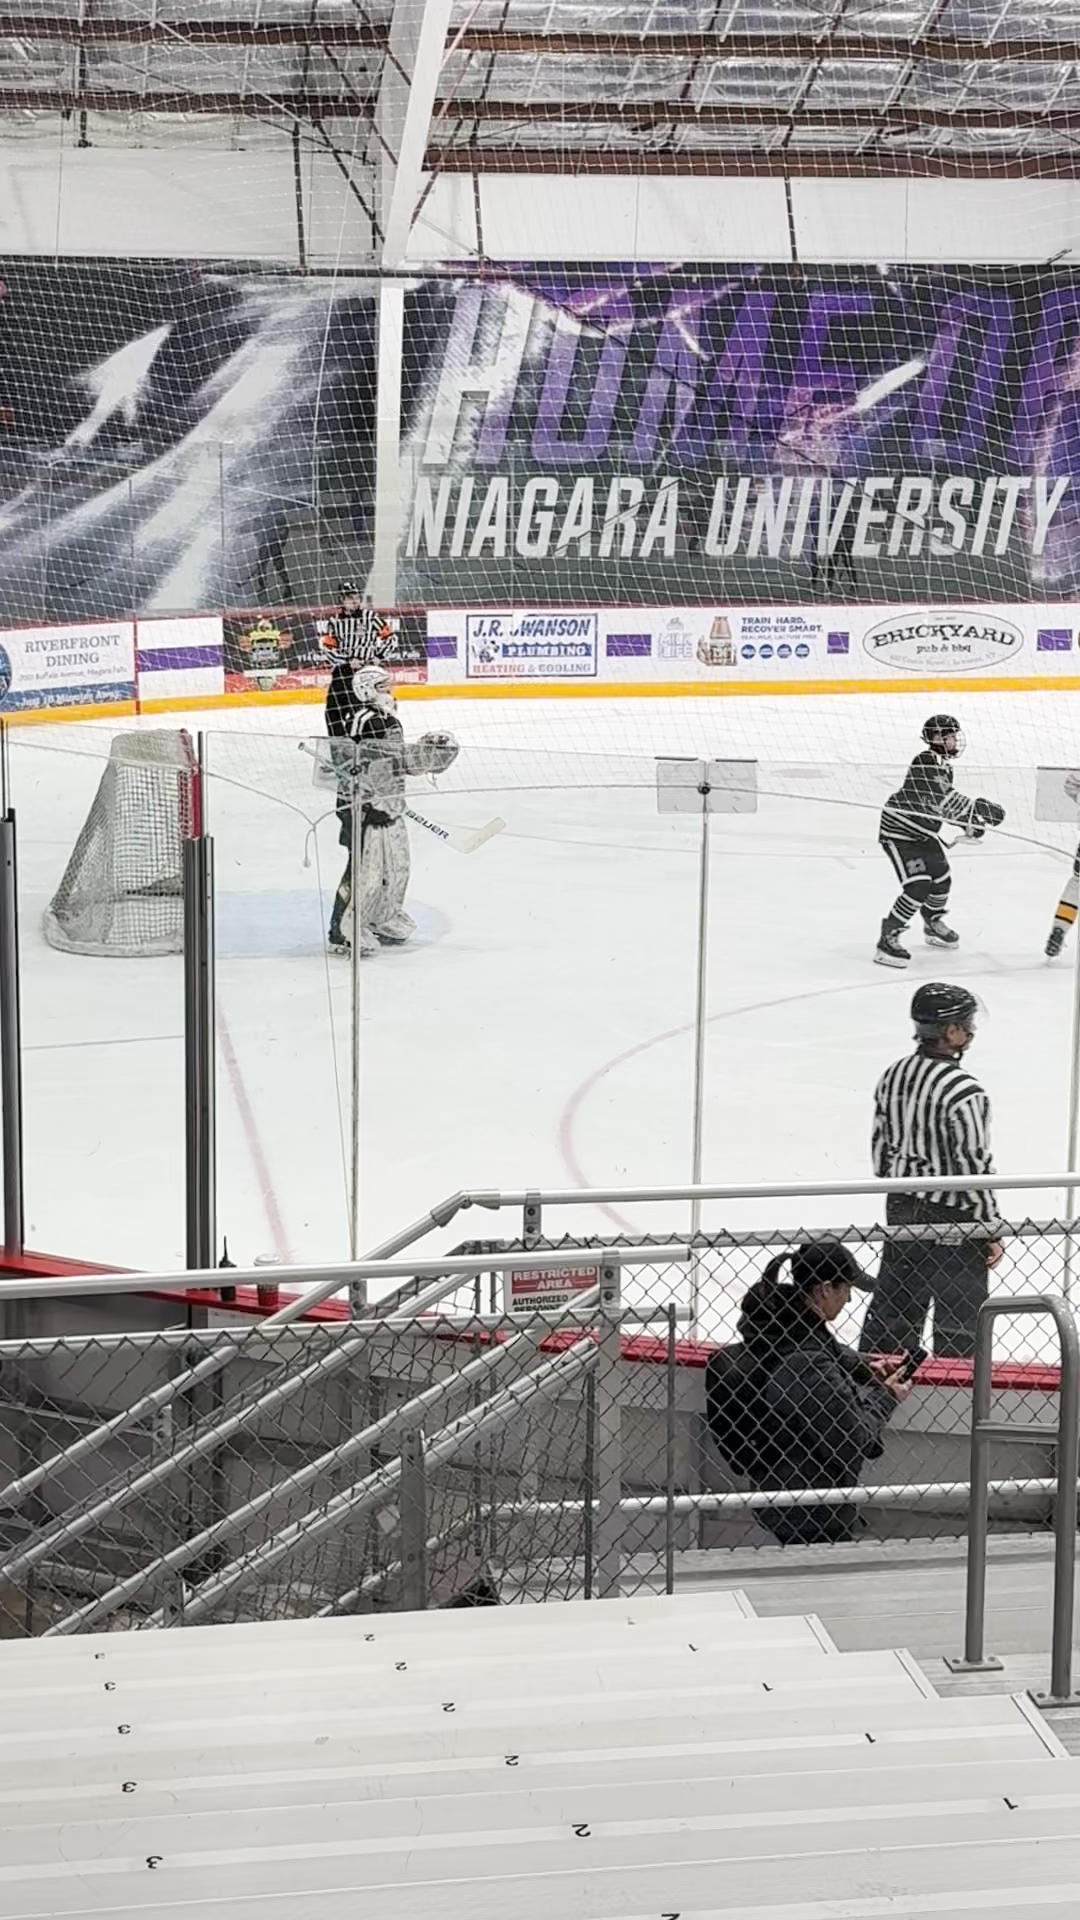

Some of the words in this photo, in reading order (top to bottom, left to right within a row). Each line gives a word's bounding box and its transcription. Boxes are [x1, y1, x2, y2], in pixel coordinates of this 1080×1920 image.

[418, 286, 874, 465] HOME
[405, 476, 678, 557] NIAGARA
[704, 475, 1070, 557] UNIVERSITY
[741, 616, 771, 625] TRAIN
[473, 619, 503, 637] J.R.
[741, 625, 786, 634] RECOVER
[872, 624, 1016, 648] BRICKYARD
[25, 635, 120, 653] RIVERFRONT
[916, 644, 938, 654] pub
[940, 644, 948, 653] &
[951, 644, 971, 653] bbq
[507, 645, 587, 656] PLUMBING
[46, 653, 99, 667] DINING
[472, 664, 525, 674] HEATING
[528, 664, 536, 673] &
[538, 663, 592, 673] COOLING
[513, 1266, 596, 1281] RESTRICTED
[536, 1279, 573, 1290] AREA
[512, 1294, 569, 1307] AUTHORIZED
[513, 1303, 562, 1313] PERSONN
[394, 1661, 408, 1671] 2
[103, 1682, 116, 1691] 3
[441, 1702, 456, 1713] 2
[117, 1724, 131, 1735] 3
[504, 1755, 520, 1767] 2
[121, 1781, 138, 1793] 3
[1002, 1797, 1019, 1810] 1
[571, 1823, 592, 1838] 2
[145, 1855, 164, 1870] 3
